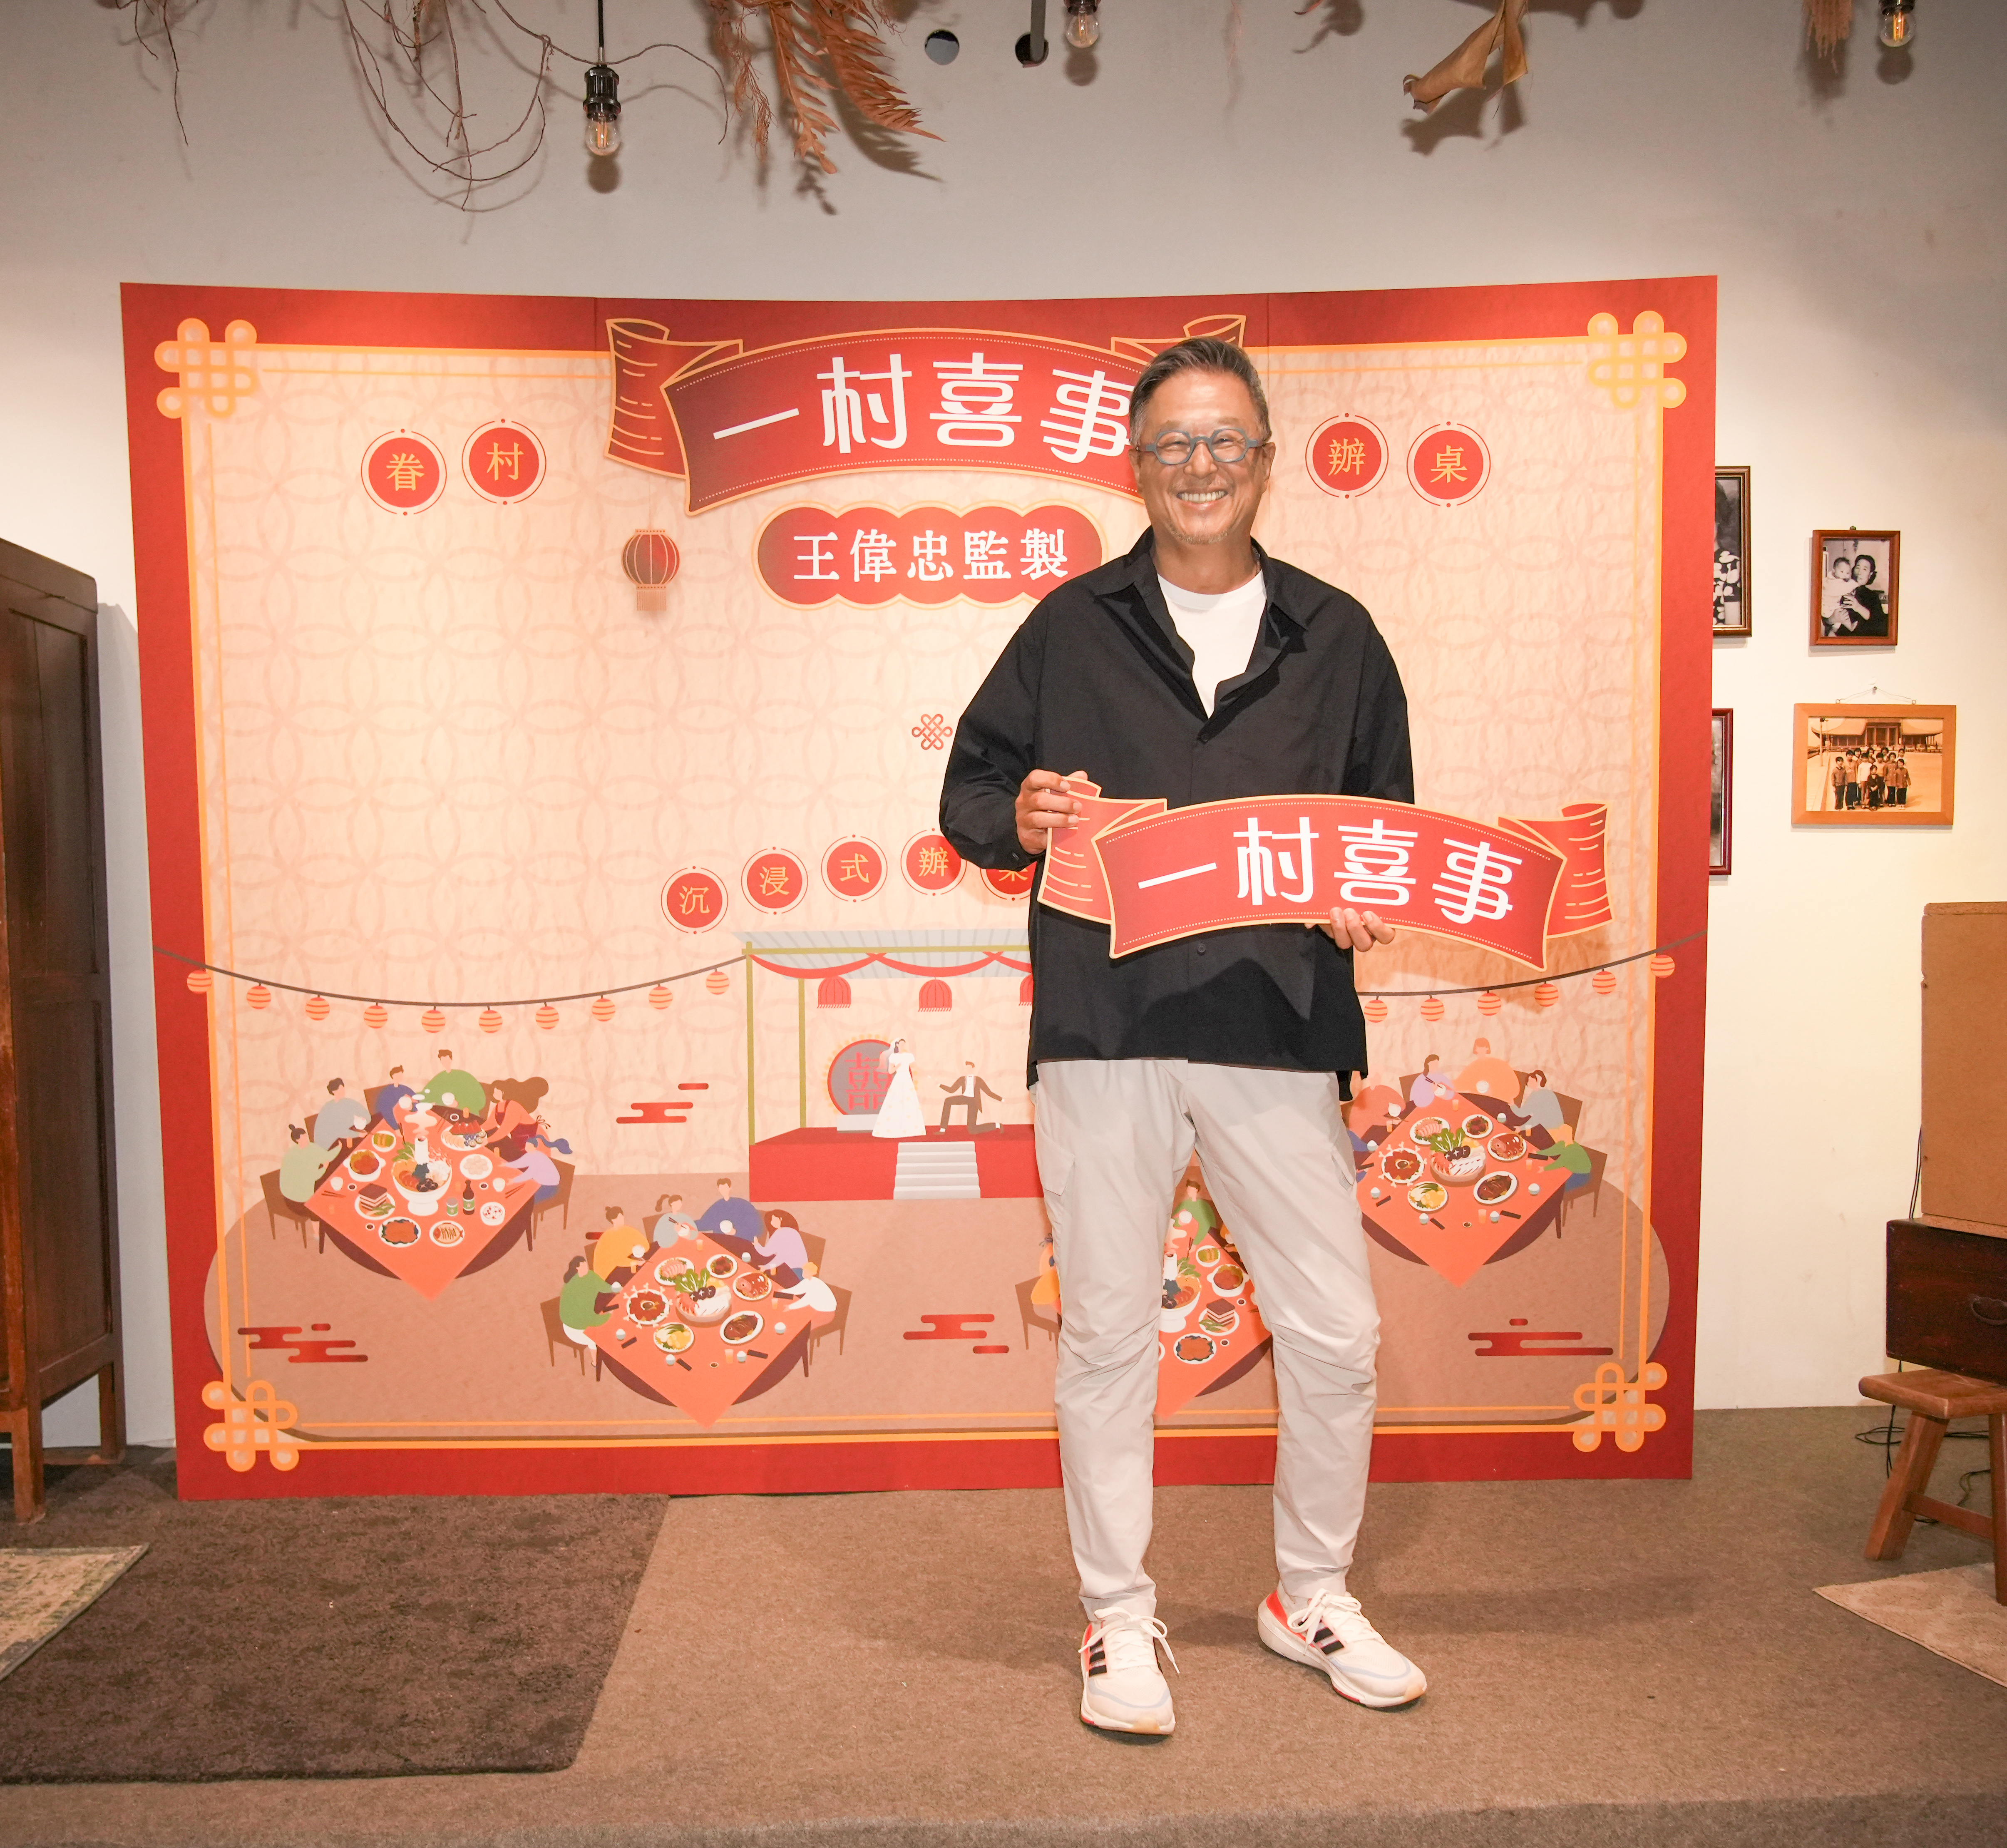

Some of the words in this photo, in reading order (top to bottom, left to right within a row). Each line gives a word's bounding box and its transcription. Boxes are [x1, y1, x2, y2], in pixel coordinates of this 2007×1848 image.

[713, 353, 1131, 463] 一村喜事
[386, 442, 524, 491] 眷村
[1328, 438, 1468, 483] 辦桌
[794, 528, 1069, 582] 王偉忠監製
[1138, 817, 1523, 924] 一村喜事
